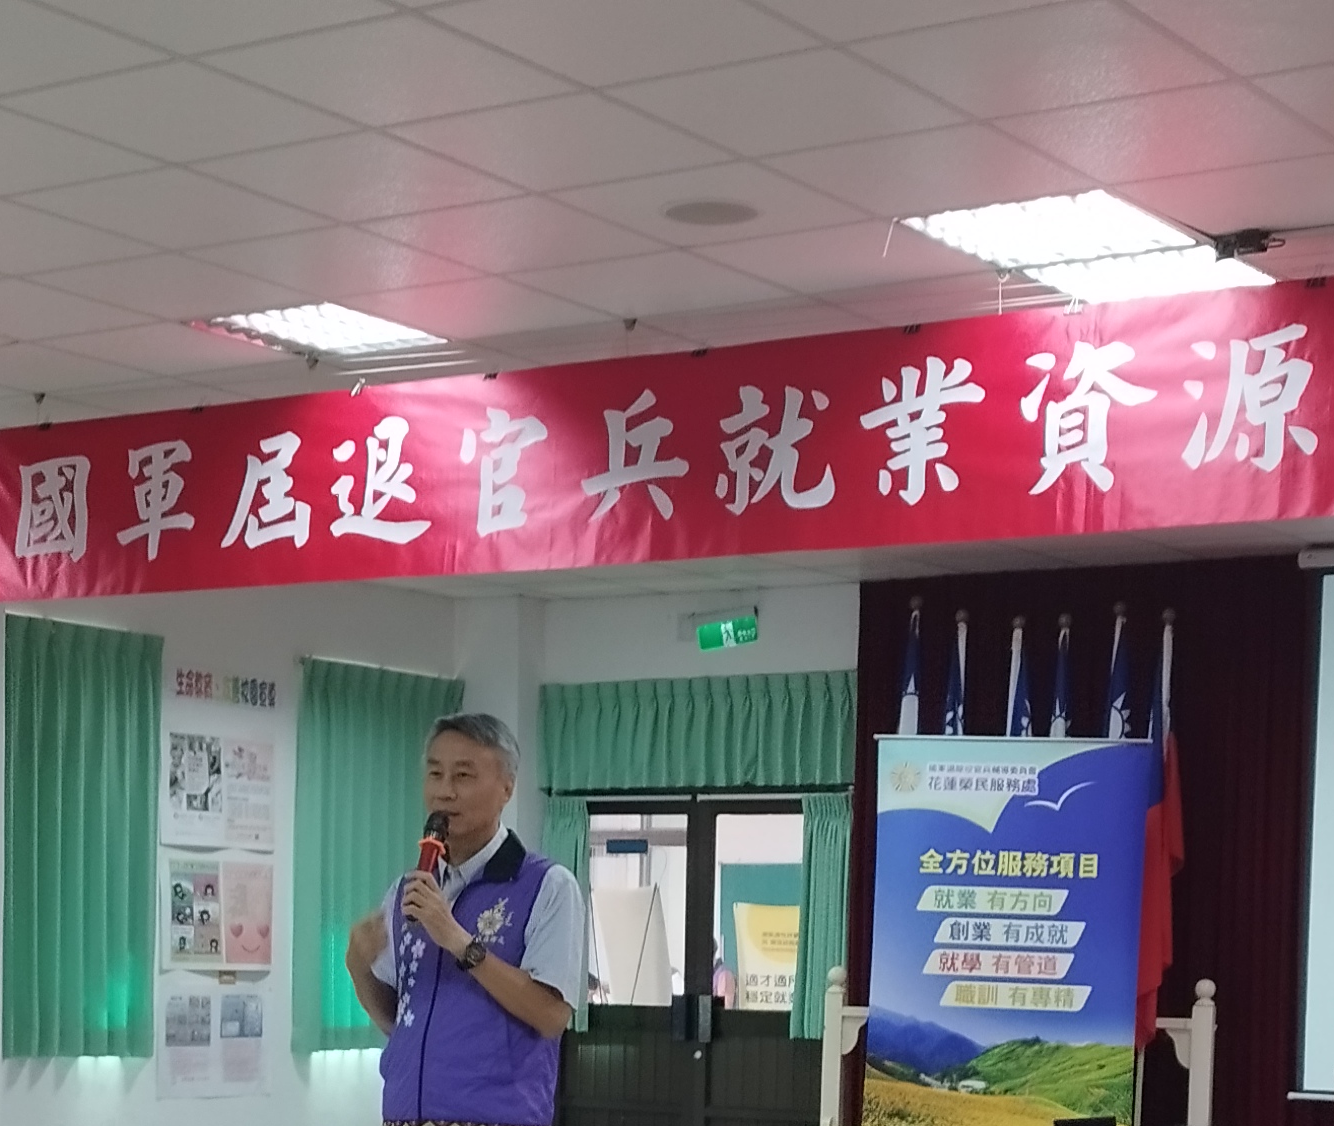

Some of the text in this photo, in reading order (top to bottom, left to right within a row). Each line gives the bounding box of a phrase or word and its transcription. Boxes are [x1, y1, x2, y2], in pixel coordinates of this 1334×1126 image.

[928, 776, 1038, 793] 花蓮榮民服務處
[919, 849, 1099, 879] 全方位服務項目
[934, 889, 1053, 913] 就業 有方向
[949, 920, 1069, 945] 創業 有成就
[939, 951, 1058, 976] 就學 有管道
[955, 983, 999, 1005] 職訓
